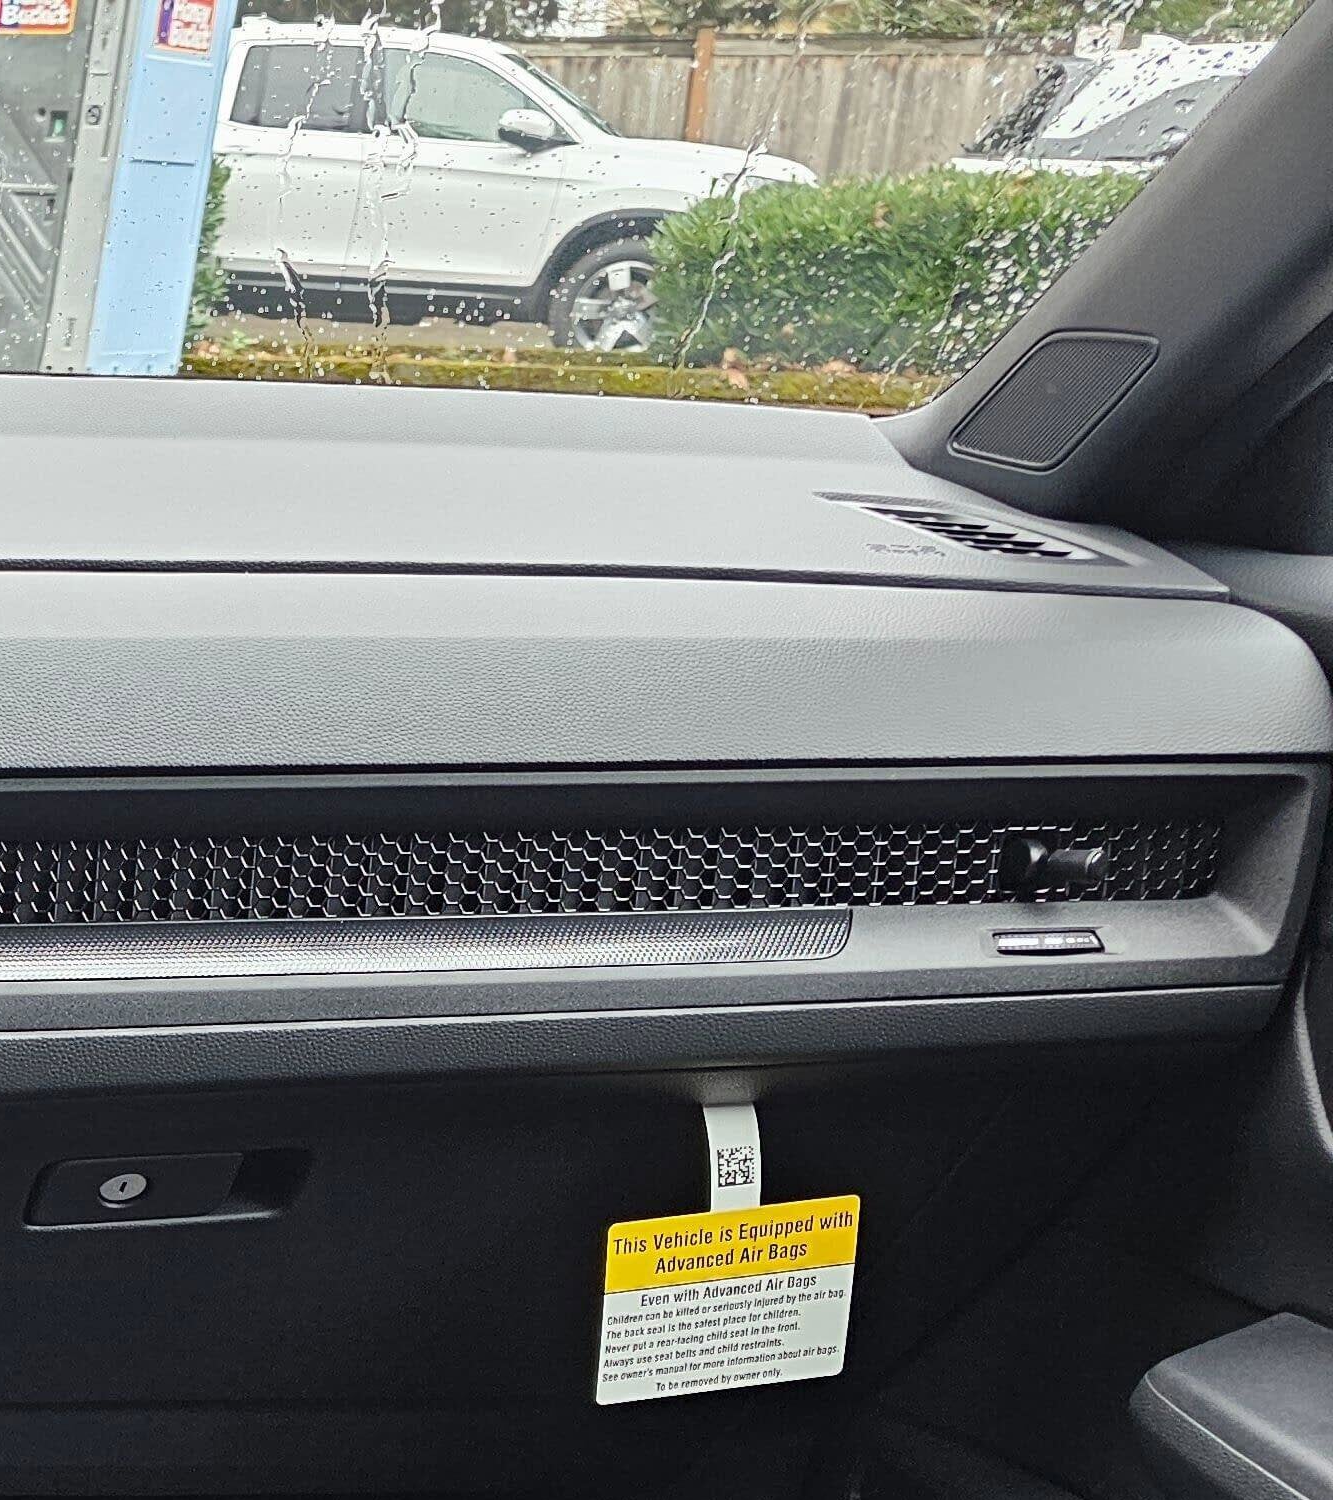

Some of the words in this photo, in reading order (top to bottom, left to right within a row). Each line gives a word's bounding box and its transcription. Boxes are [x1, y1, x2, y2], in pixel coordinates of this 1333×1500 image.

[614, 1237, 647, 1254] This
[653, 1228, 712, 1250] Vehicle
[719, 1226, 733, 1242] is
[739, 1215, 814, 1242] Equipped
[820, 1211, 853, 1230] with
[655, 1248, 734, 1274] Advanced
[740, 1246, 763, 1263] Air
[769, 1243, 807, 1260] Bags
[641, 1294, 669, 1306] Even
[674, 1290, 699, 1303] with
[703, 1280, 762, 1299] Advanced
[766, 1278, 784, 1291] Air
[788, 1276, 817, 1289] Bags
[607, 1314, 643, 1325] Children
[646, 1312, 660, 1320] can
[676, 1306, 700, 1317] killed
[713, 1300, 752, 1312] seriously
[754, 1295, 784, 1308] injured
[786, 1294, 796, 1304] by
[798, 1292, 811, 1301] the
[814, 1290, 826, 1299] air
[828, 1289, 846, 1298] bag.
[605, 1343, 630, 1354] Never
[632, 1342, 647, 1352] put
[657, 1335, 704, 1348] rear-facing
[707, 1330, 728, 1341] child
[730, 1328, 748, 1338] seat
[751, 1327, 759, 1335] in
[761, 1324, 775, 1334] the
[777, 1322, 801, 1331] front.
[607, 1331, 621, 1340] The
[624, 1327, 644, 1338] back
[647, 1324, 665, 1335] seat
[668, 1324, 675, 1332] is
[678, 1320, 691, 1331] the
[694, 1315, 720, 1328] safest
[723, 1314, 746, 1326] place
[749, 1313, 761, 1322] for
[763, 1309, 801, 1320] children.
[603, 1373, 618, 1382] See
[620, 1368, 653, 1380] owner's
[655, 1364, 687, 1375] manual
[689, 1362, 701, 1371] for
[703, 1359, 724, 1369] more
[727, 1353, 775, 1366] information
[777, 1350, 801, 1359] about
[803, 1348, 815, 1357] air
[817, 1346, 839, 1355] bags.
[604, 1357, 634, 1368] Always
[637, 1355, 652, 1363] use
[655, 1352, 673, 1362] seat
[675, 1349, 696, 1359] belts
[699, 1346, 714, 1355] and
[717, 1343, 738, 1353] child
[741, 1339, 784, 1350] restraints.
[656, 1382, 665, 1391] To
[668, 1382, 678, 1390] be
[681, 1376, 718, 1388] removed
[721, 1375, 732, 1383] by
[734, 1372, 760, 1381] owner
[762, 1368, 782, 1378] only.
